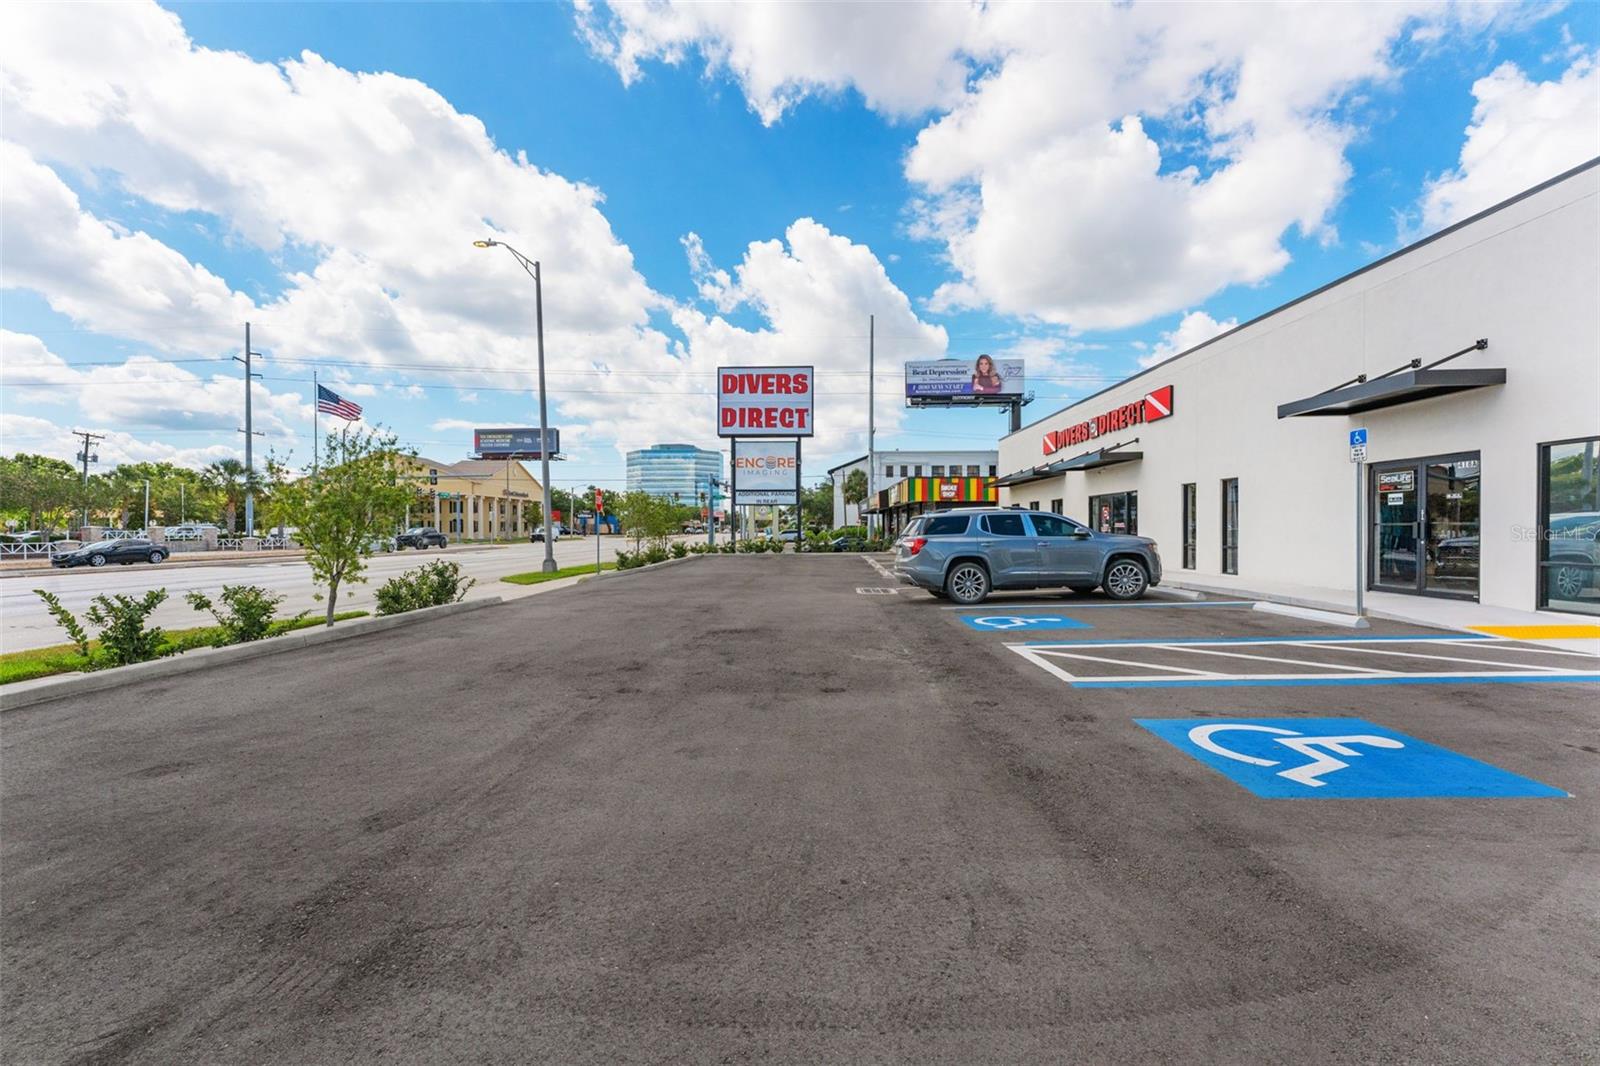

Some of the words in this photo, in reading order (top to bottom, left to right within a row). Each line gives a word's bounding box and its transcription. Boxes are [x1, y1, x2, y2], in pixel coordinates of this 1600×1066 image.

[929, 368, 968, 377] Depression
[722, 373, 809, 395] DIVERS
[721, 407, 809, 428] DIRECT
[1056, 422, 1090, 449] DIVERS
[1099, 400, 1145, 435] DIRECT
[736, 456, 795, 470] ENCORE
